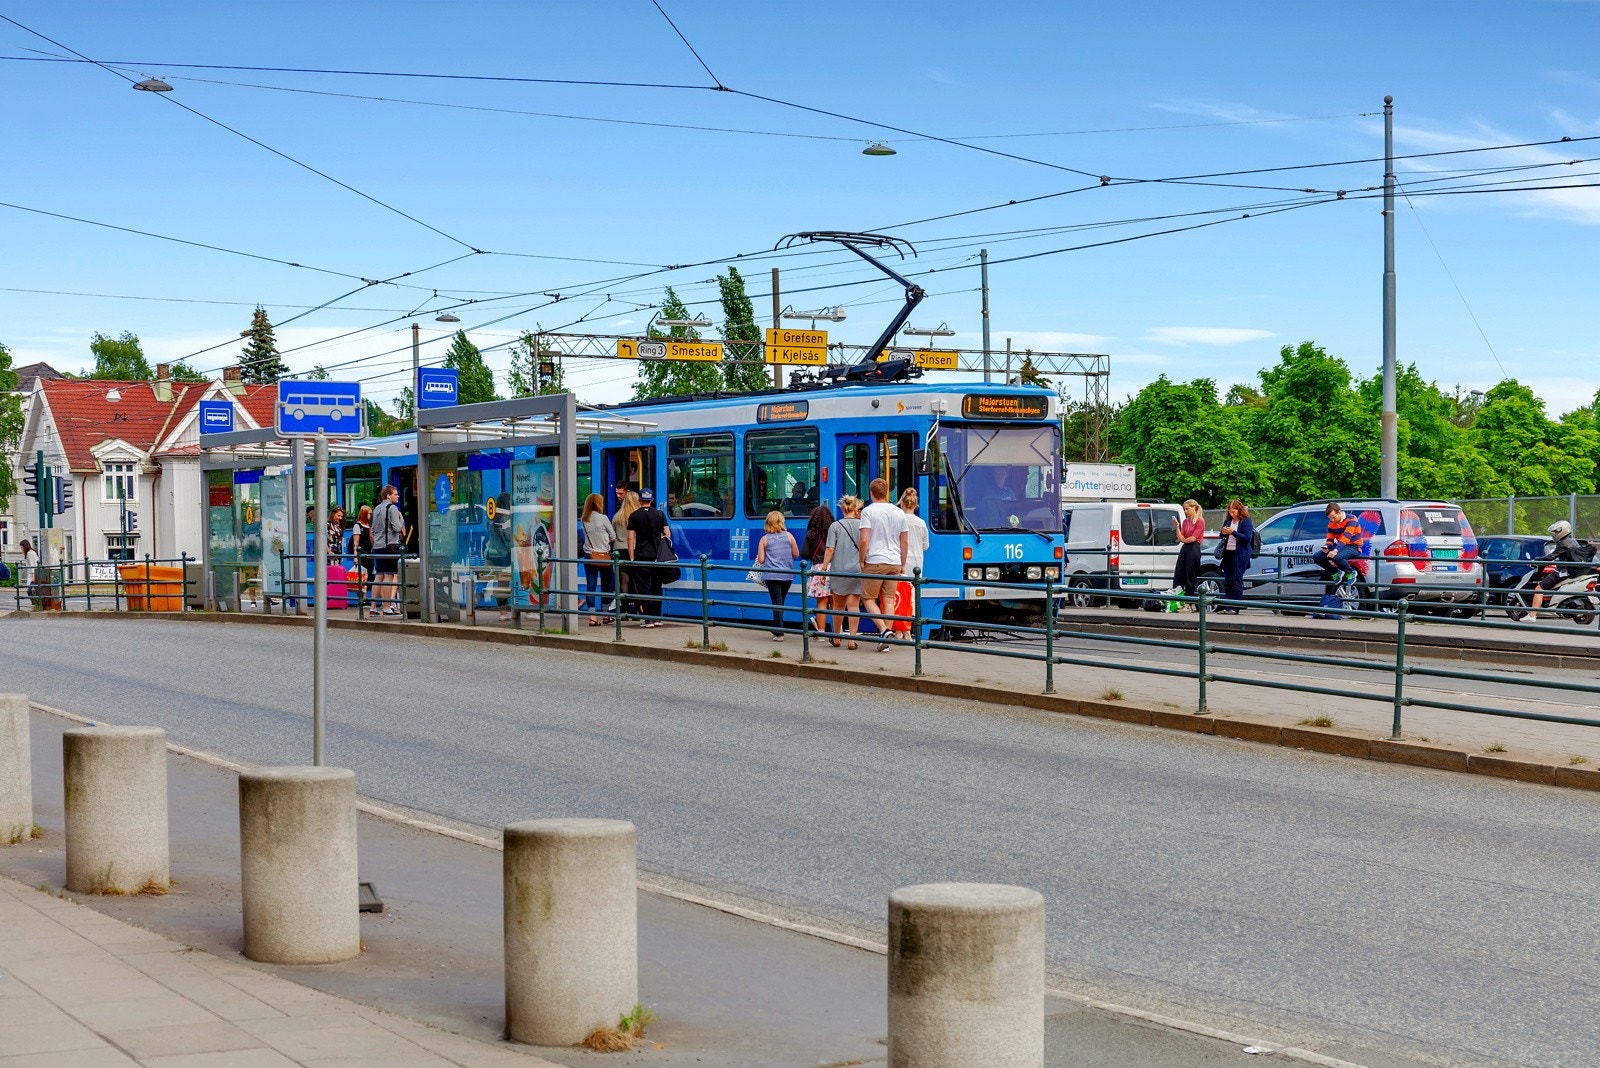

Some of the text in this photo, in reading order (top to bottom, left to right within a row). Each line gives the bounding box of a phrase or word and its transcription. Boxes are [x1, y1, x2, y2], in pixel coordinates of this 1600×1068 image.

[783, 332, 823, 344] Grefsen
[640, 346, 663, 356] Ring 3
[671, 346, 718, 357] Smestad
[783, 349, 819, 362] Kjelsås
[919, 353, 952, 365] Sinsen
[979, 397, 1018, 407] Majorstuen
[1061, 480, 1132, 493] sloflyttehjelp.no
[488, 501, 494, 515] B
[1004, 543, 1023, 560] 116
[1287, 557, 1293, 569] &
